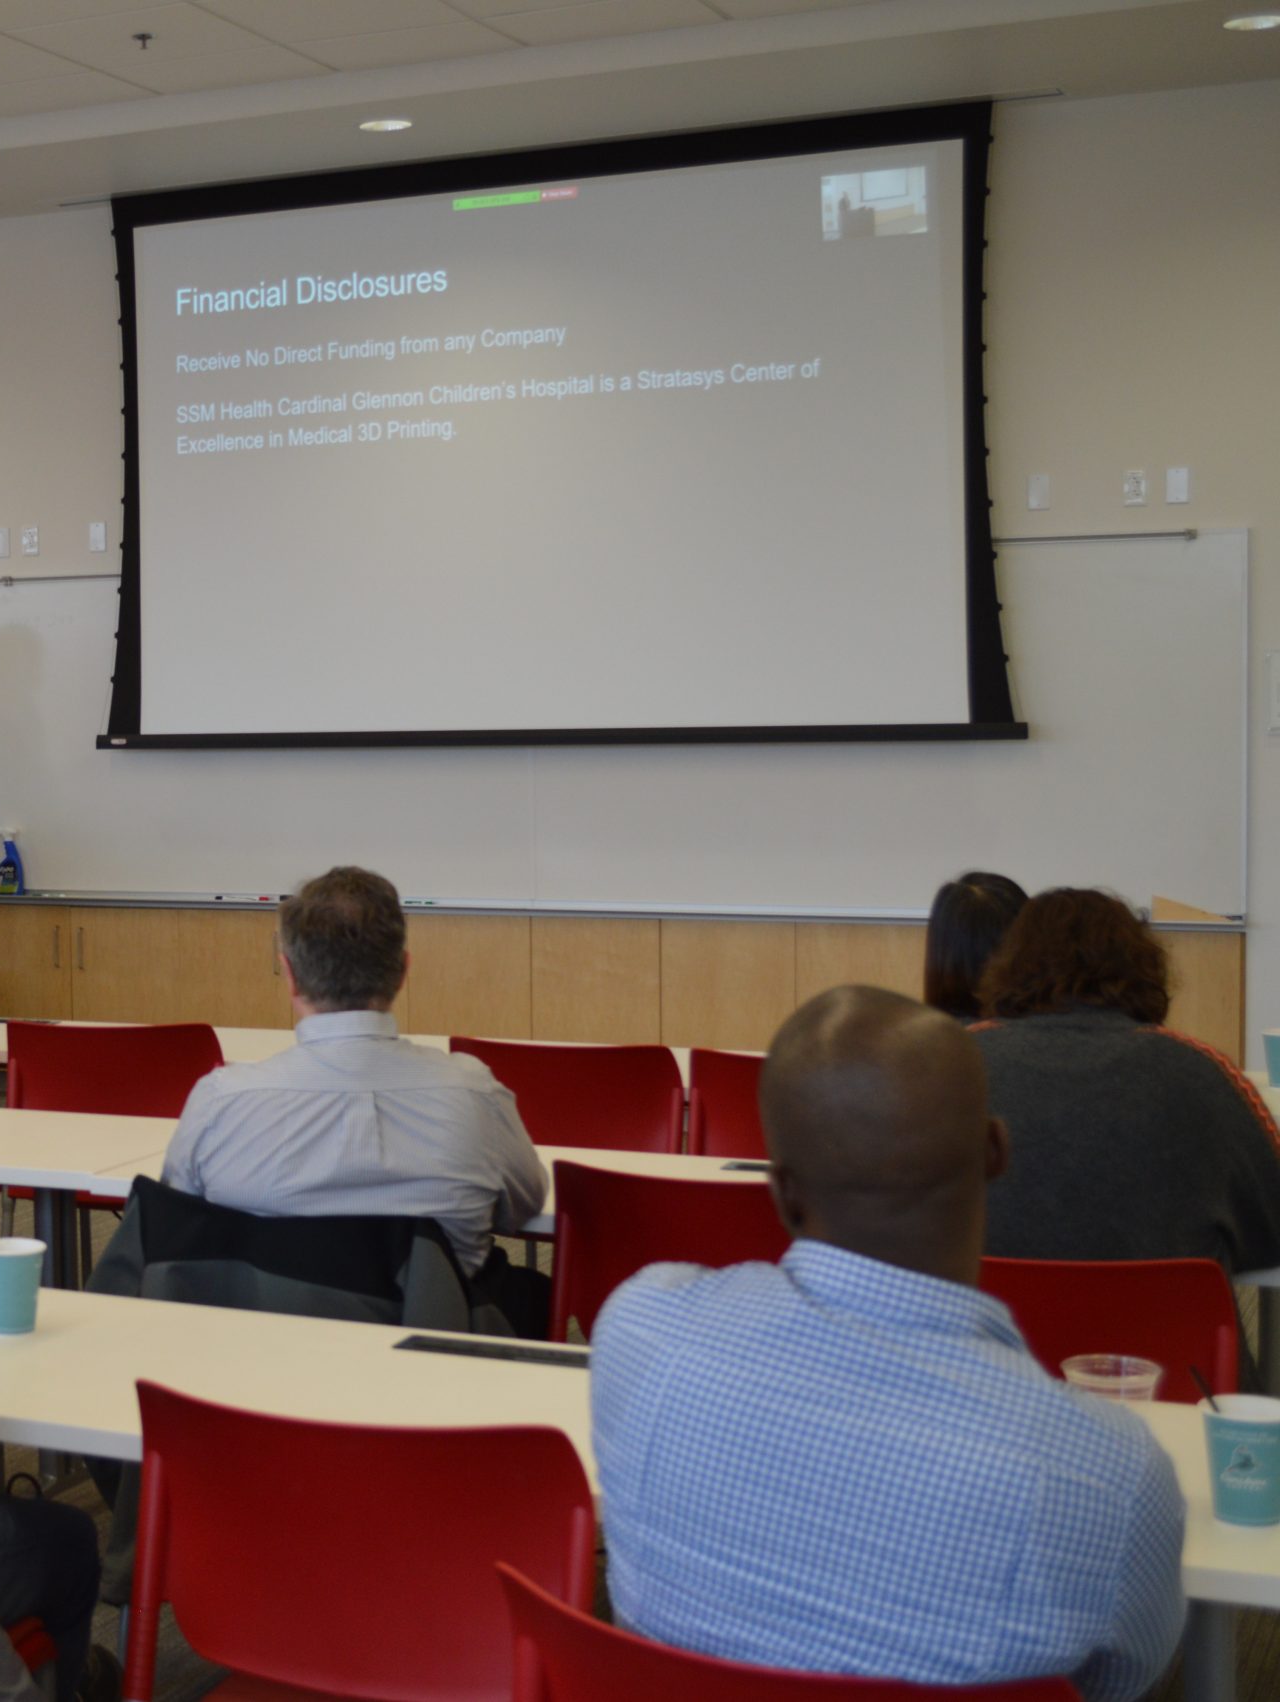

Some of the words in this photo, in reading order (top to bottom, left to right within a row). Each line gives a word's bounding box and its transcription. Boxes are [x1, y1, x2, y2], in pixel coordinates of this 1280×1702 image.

[176, 279, 288, 316] Financial
[296, 269, 449, 305] Disclosures
[176, 352, 241, 374] Receive
[246, 349, 269, 367] No
[274, 345, 322, 365] Direct
[328, 338, 396, 361] Funding
[400, 336, 439, 355] from
[444, 333, 476, 353] any
[481, 327, 567, 349] Company
[176, 403, 215, 424] SSM
[220, 399, 272, 420] Health
[277, 393, 347, 416] Cardinal
[352, 389, 424, 410] Glennon
[429, 381, 516, 404] Children's
[522, 375, 594, 399] Hospital
[599, 374, 614, 392] is
[620, 376, 631, 391] a
[637, 368, 725, 390] Stratasys
[730, 362, 795, 383] Center
[800, 358, 821, 378] of
[176, 433, 264, 455] Excellence
[269, 430, 283, 447] in
[288, 425, 352, 447] Medical
[357, 421, 381, 442] 3D
[387, 419, 457, 441] Printing.
